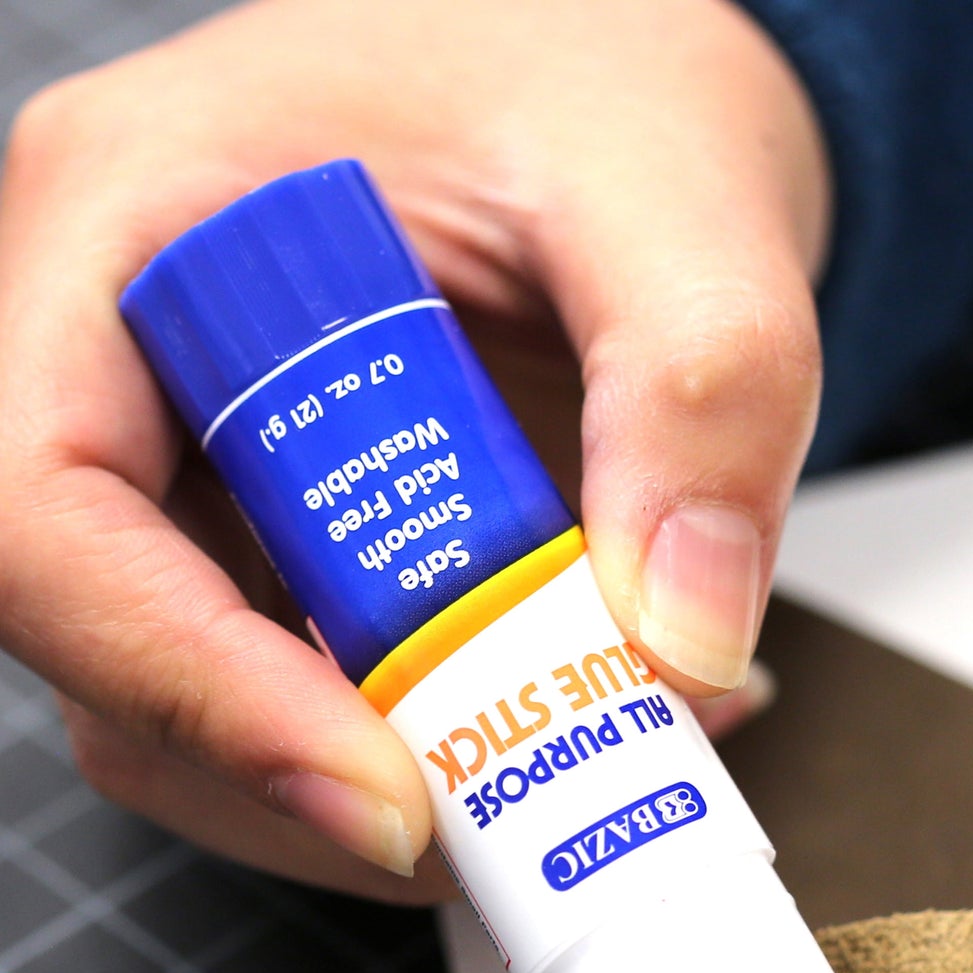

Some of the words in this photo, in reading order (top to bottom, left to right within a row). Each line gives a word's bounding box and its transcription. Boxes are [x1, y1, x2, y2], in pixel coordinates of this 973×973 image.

[324, 373, 361, 400] oz.
[369, 353, 405, 385] 0.7
[259, 414, 287, 453] g.)
[289, 393, 324, 430] (21
[303, 417, 450, 510] Washable
[393, 452, 460, 506] Acid
[327, 490, 393, 542] Free
[357, 493, 473, 572] Smooth
[397, 538, 471, 591] Safe
[425, 682, 552, 795] STICK
[618, 694, 674, 734] ALL
[463, 712, 624, 830] PURPOSE
[551, 803, 662, 883] BAZIC
